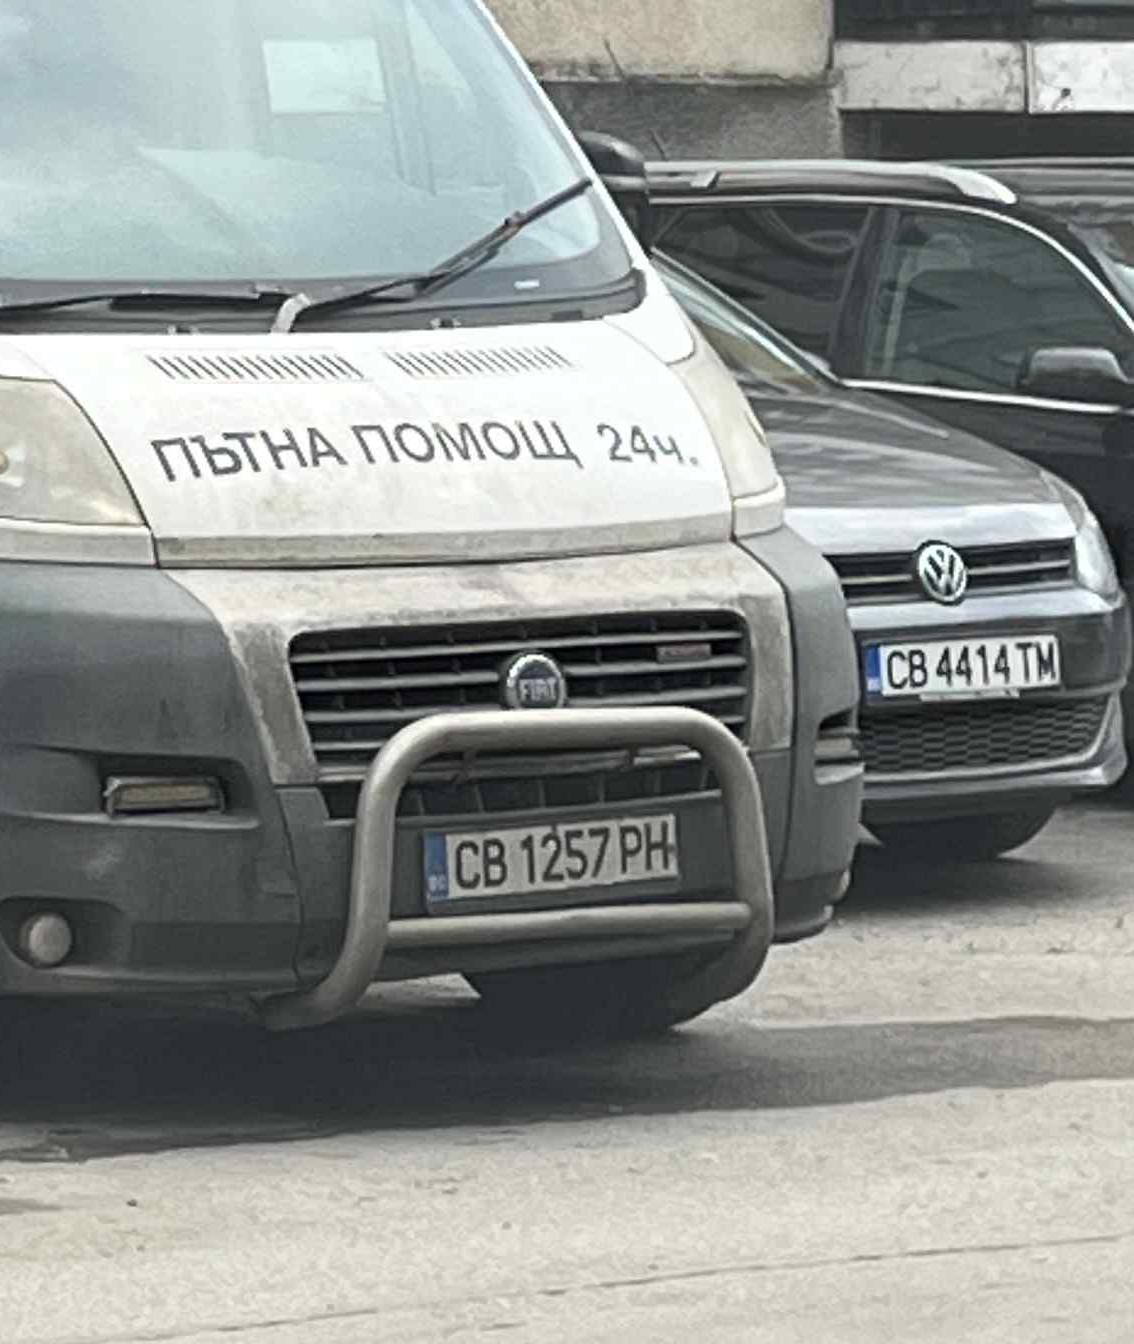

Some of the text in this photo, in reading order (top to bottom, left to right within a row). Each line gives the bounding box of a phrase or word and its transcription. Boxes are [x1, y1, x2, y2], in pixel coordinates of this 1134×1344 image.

[151, 427, 346, 481] ПЪТНА
[351, 420, 583, 468] ПОМОЩ
[517, 677, 558, 703] FIAT
[887, 642, 1056, 689] CB 4414 TM
[454, 839, 507, 890] CB
[520, 827, 611, 884] 1257
[619, 823, 670, 874] PH
